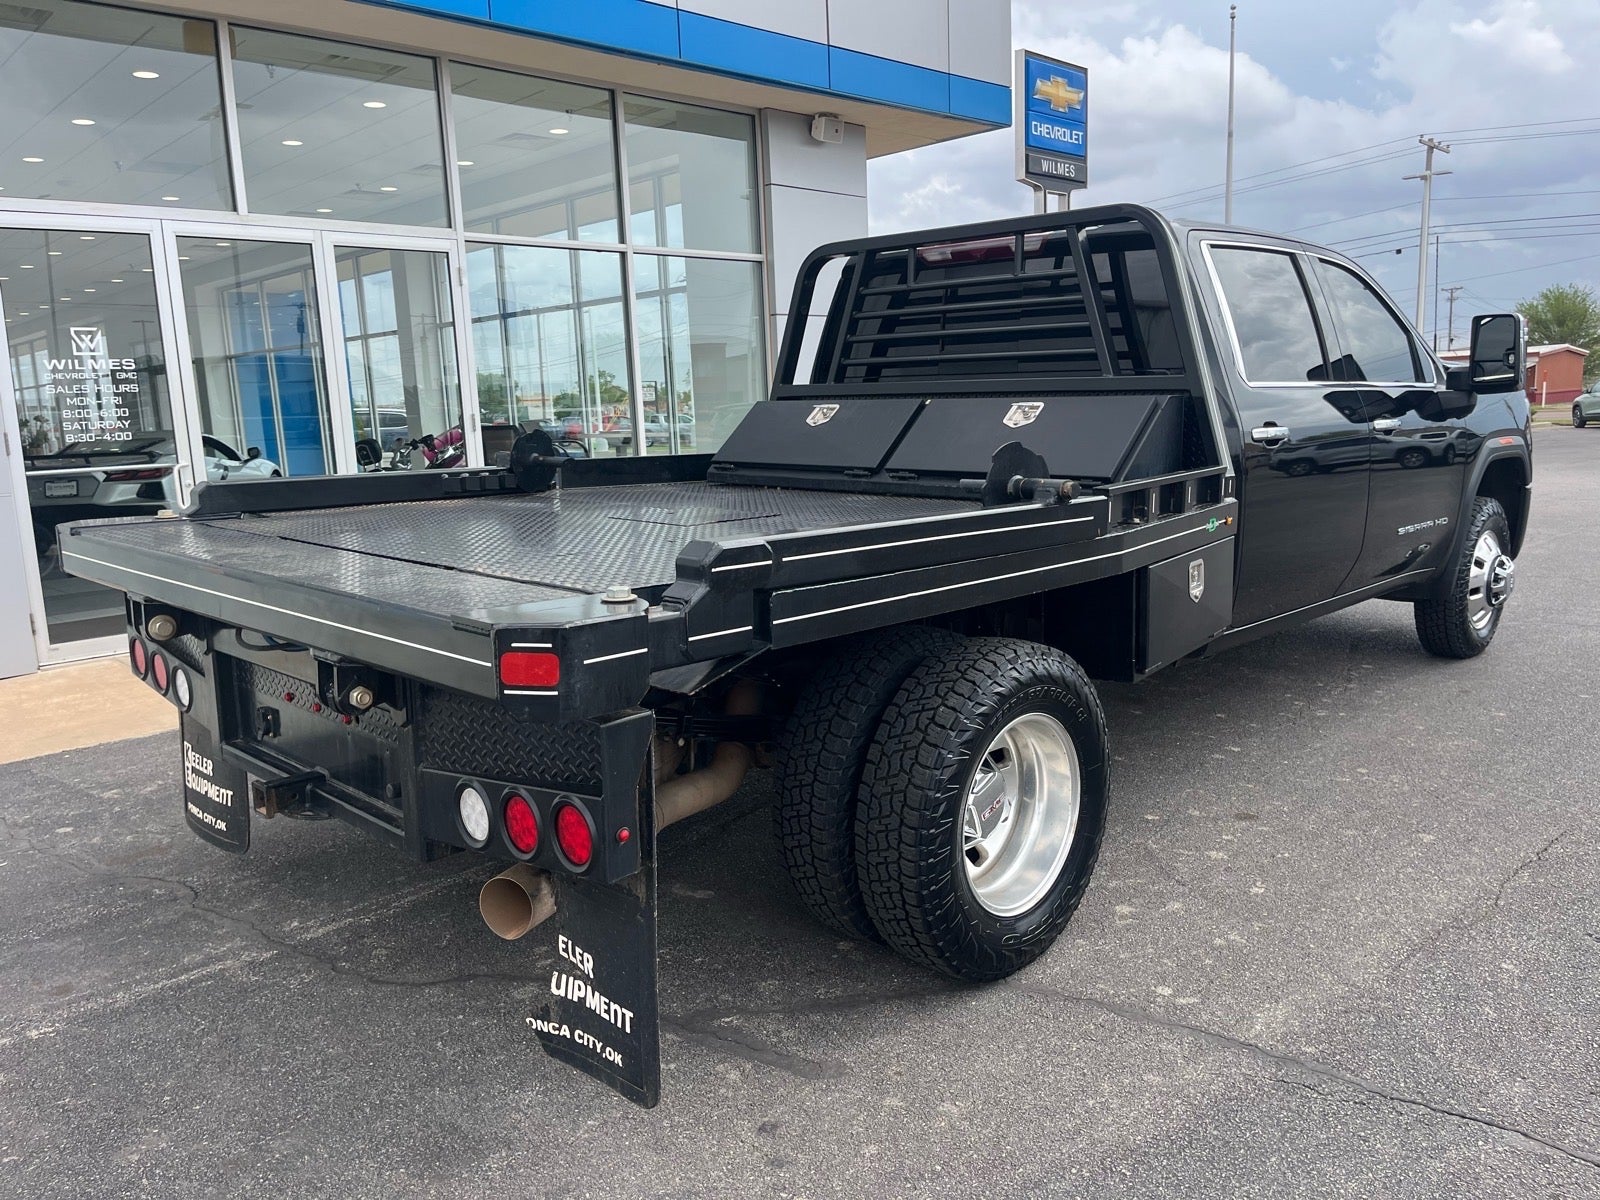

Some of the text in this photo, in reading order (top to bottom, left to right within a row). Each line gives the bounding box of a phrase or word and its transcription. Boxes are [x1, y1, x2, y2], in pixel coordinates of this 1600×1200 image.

[1032, 121, 1084, 144] CHEVROLET
[1041, 159, 1076, 178] WILMES
[43, 358, 136, 370] WILMES
[44, 371, 138, 380] CHEVROLET GMC
[46, 384, 139, 394] SALES HOURS
[66, 396, 123, 406] MON-FRI
[63, 408, 130, 419] 8:00-6:00
[63, 420, 131, 431] SATURDAY
[65, 432, 133, 443] 8:30-4:00
[1398, 517, 1448, 535] SIERRA HD
[184, 741, 213, 776] KEELER
[185, 764, 234, 807] EQUIPMENT
